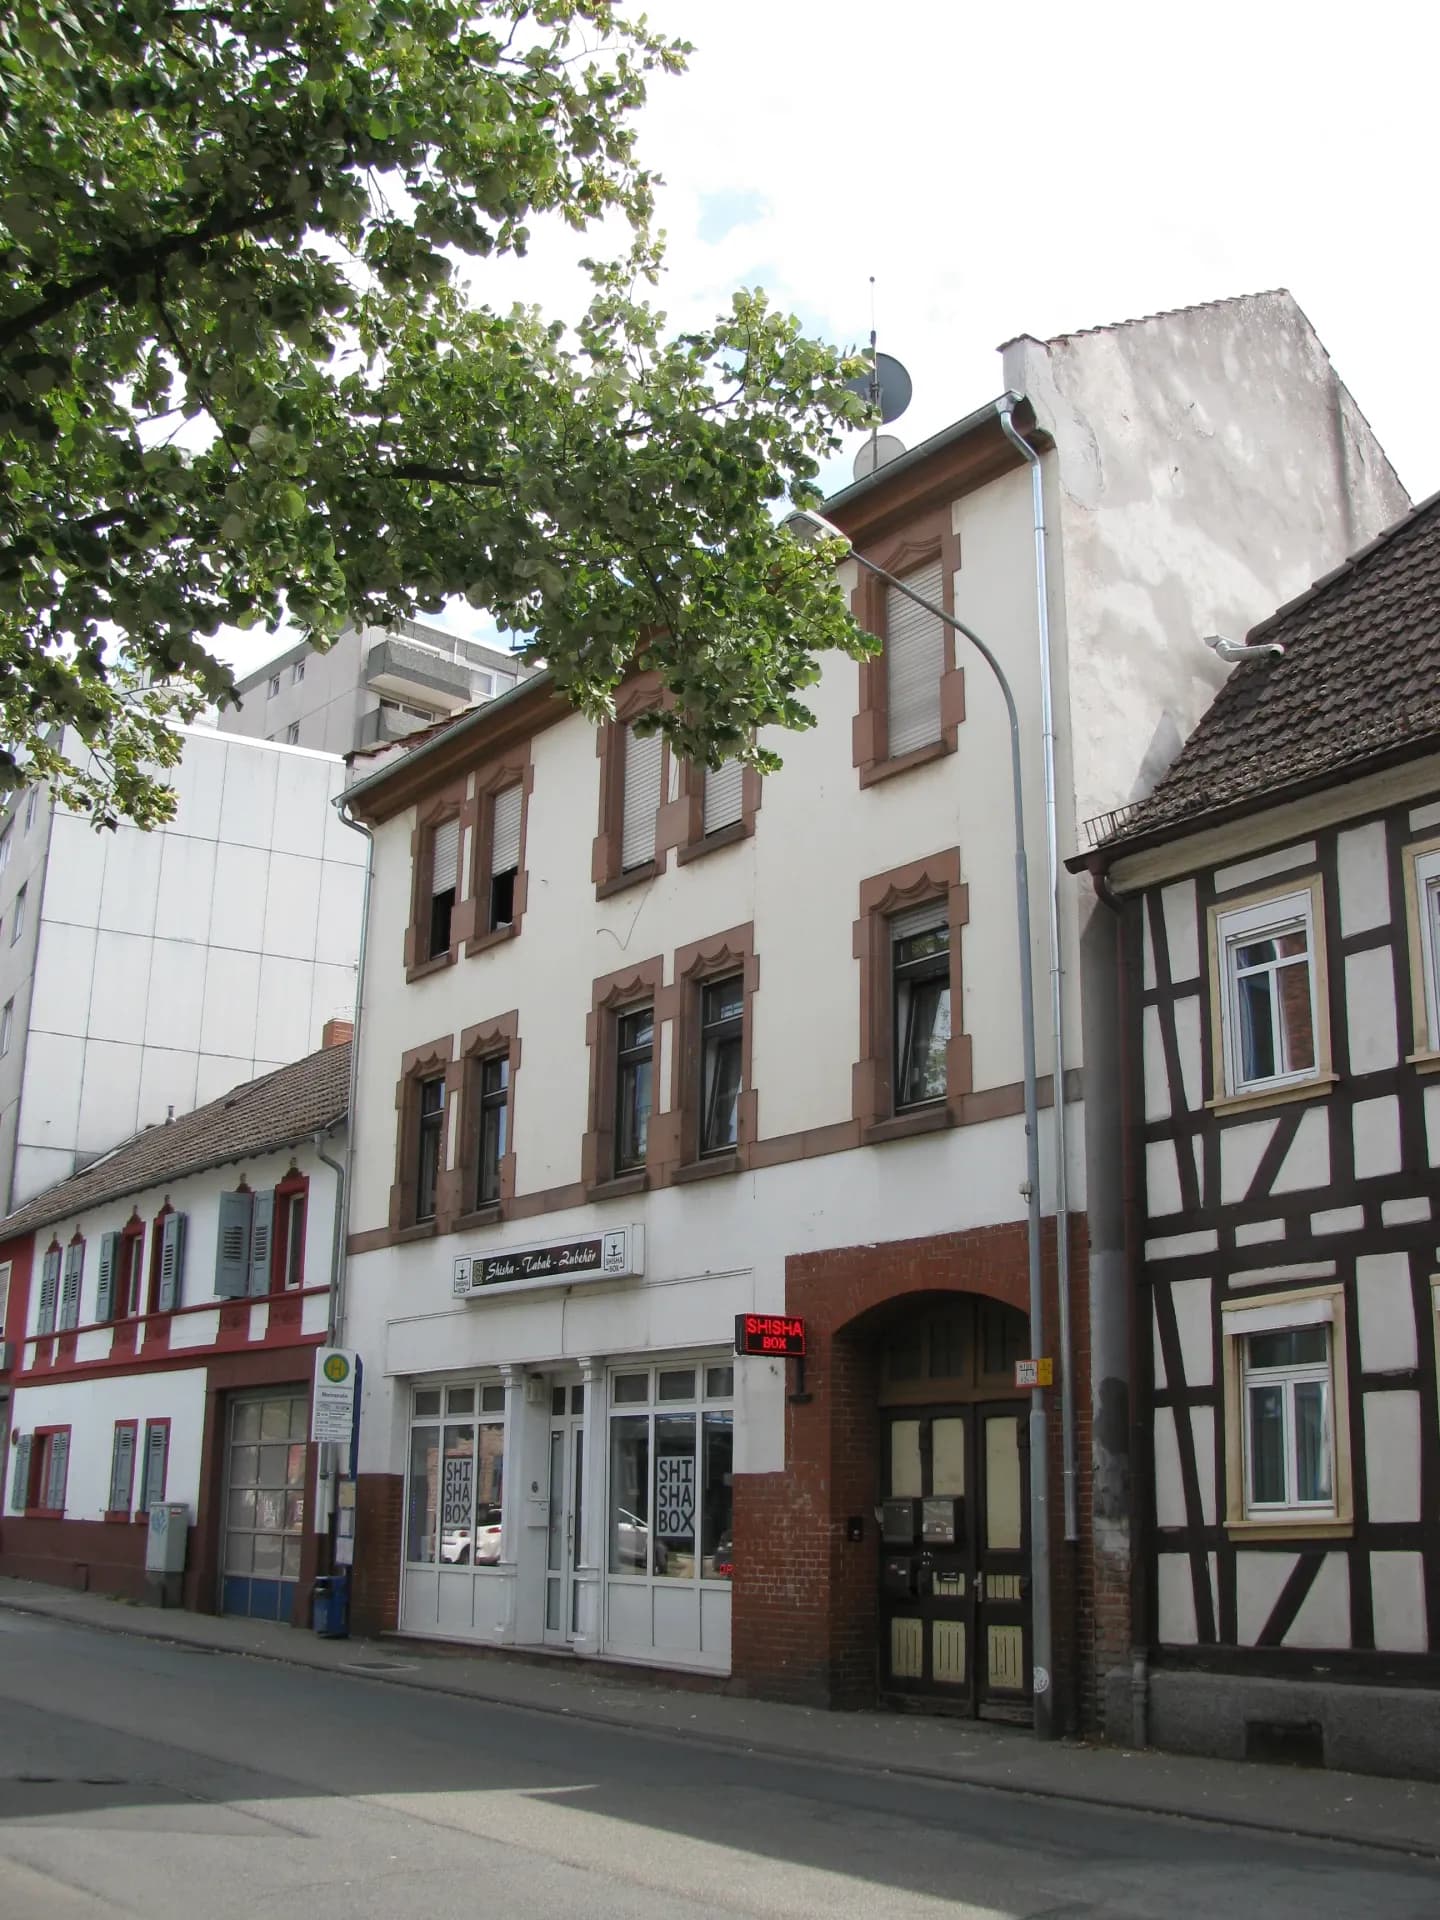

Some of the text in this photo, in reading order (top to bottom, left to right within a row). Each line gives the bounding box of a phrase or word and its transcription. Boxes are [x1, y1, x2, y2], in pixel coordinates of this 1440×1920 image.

[486, 1262, 514, 1280] Shisha
[522, 1255, 551, 1273] Tabak
[559, 1248, 597, 1267] Zubehör
[747, 1318, 802, 1336] SHISHA
[763, 1337, 786, 1349] BOX
[447, 1461, 471, 1481] SHI
[659, 1460, 692, 1483] SHI
[445, 1482, 470, 1502] SHA
[658, 1484, 692, 1508] SHA
[445, 1503, 471, 1523] BOX
[658, 1509, 695, 1533] BOX
